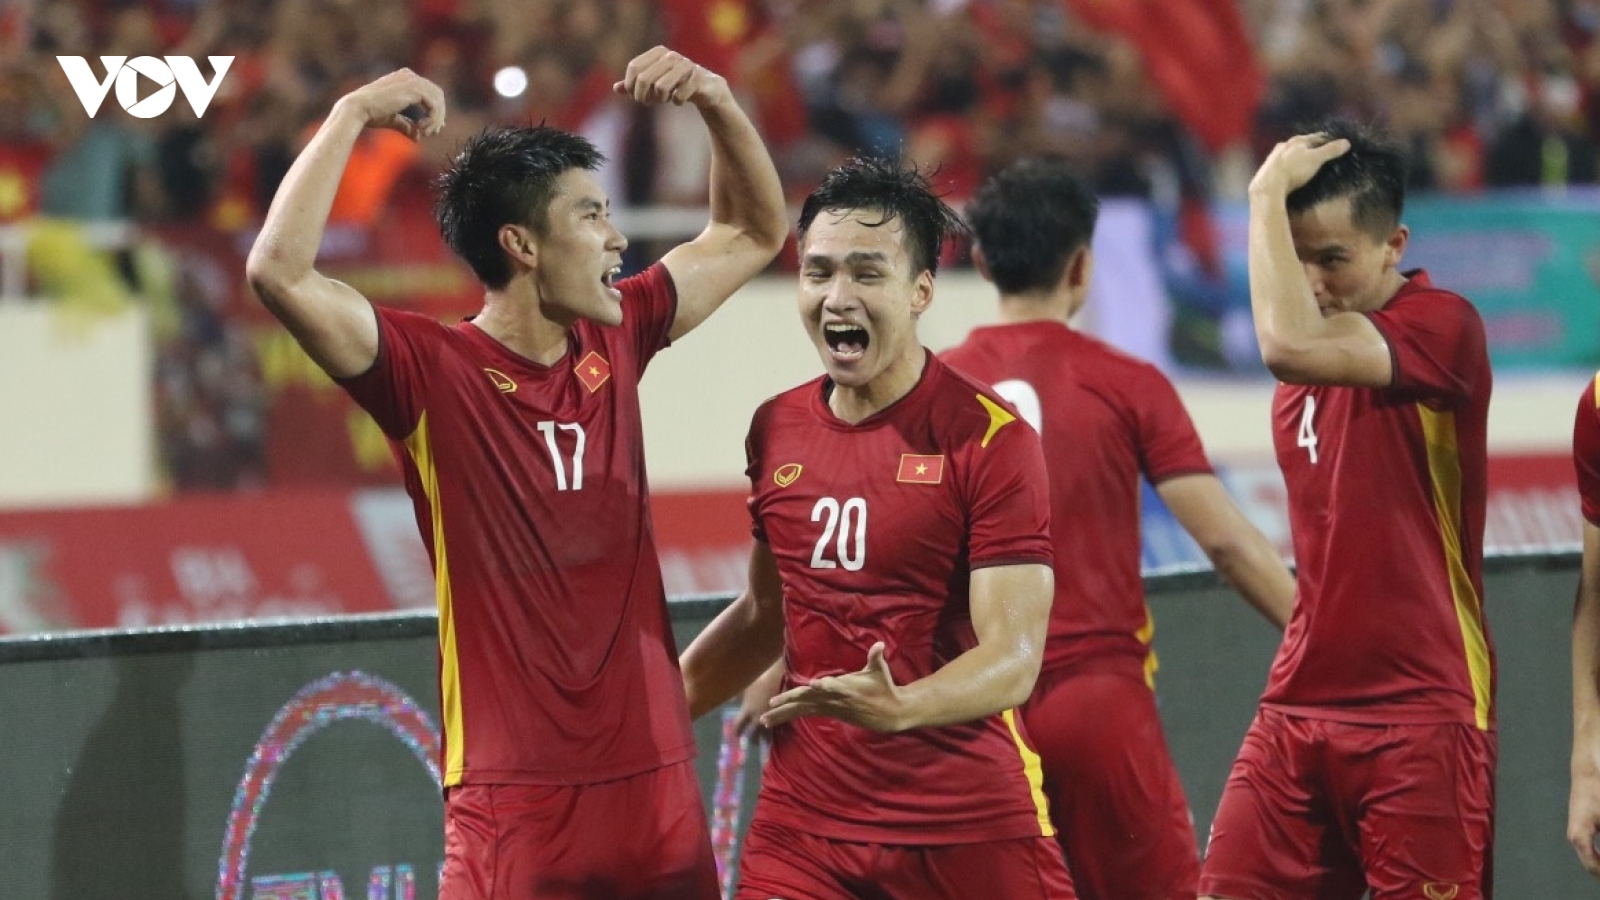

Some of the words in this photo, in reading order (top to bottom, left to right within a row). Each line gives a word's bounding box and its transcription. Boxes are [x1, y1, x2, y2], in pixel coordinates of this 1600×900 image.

[537, 420, 586, 491] 17
[1297, 395, 1318, 464] 4
[810, 497, 867, 571] 20
